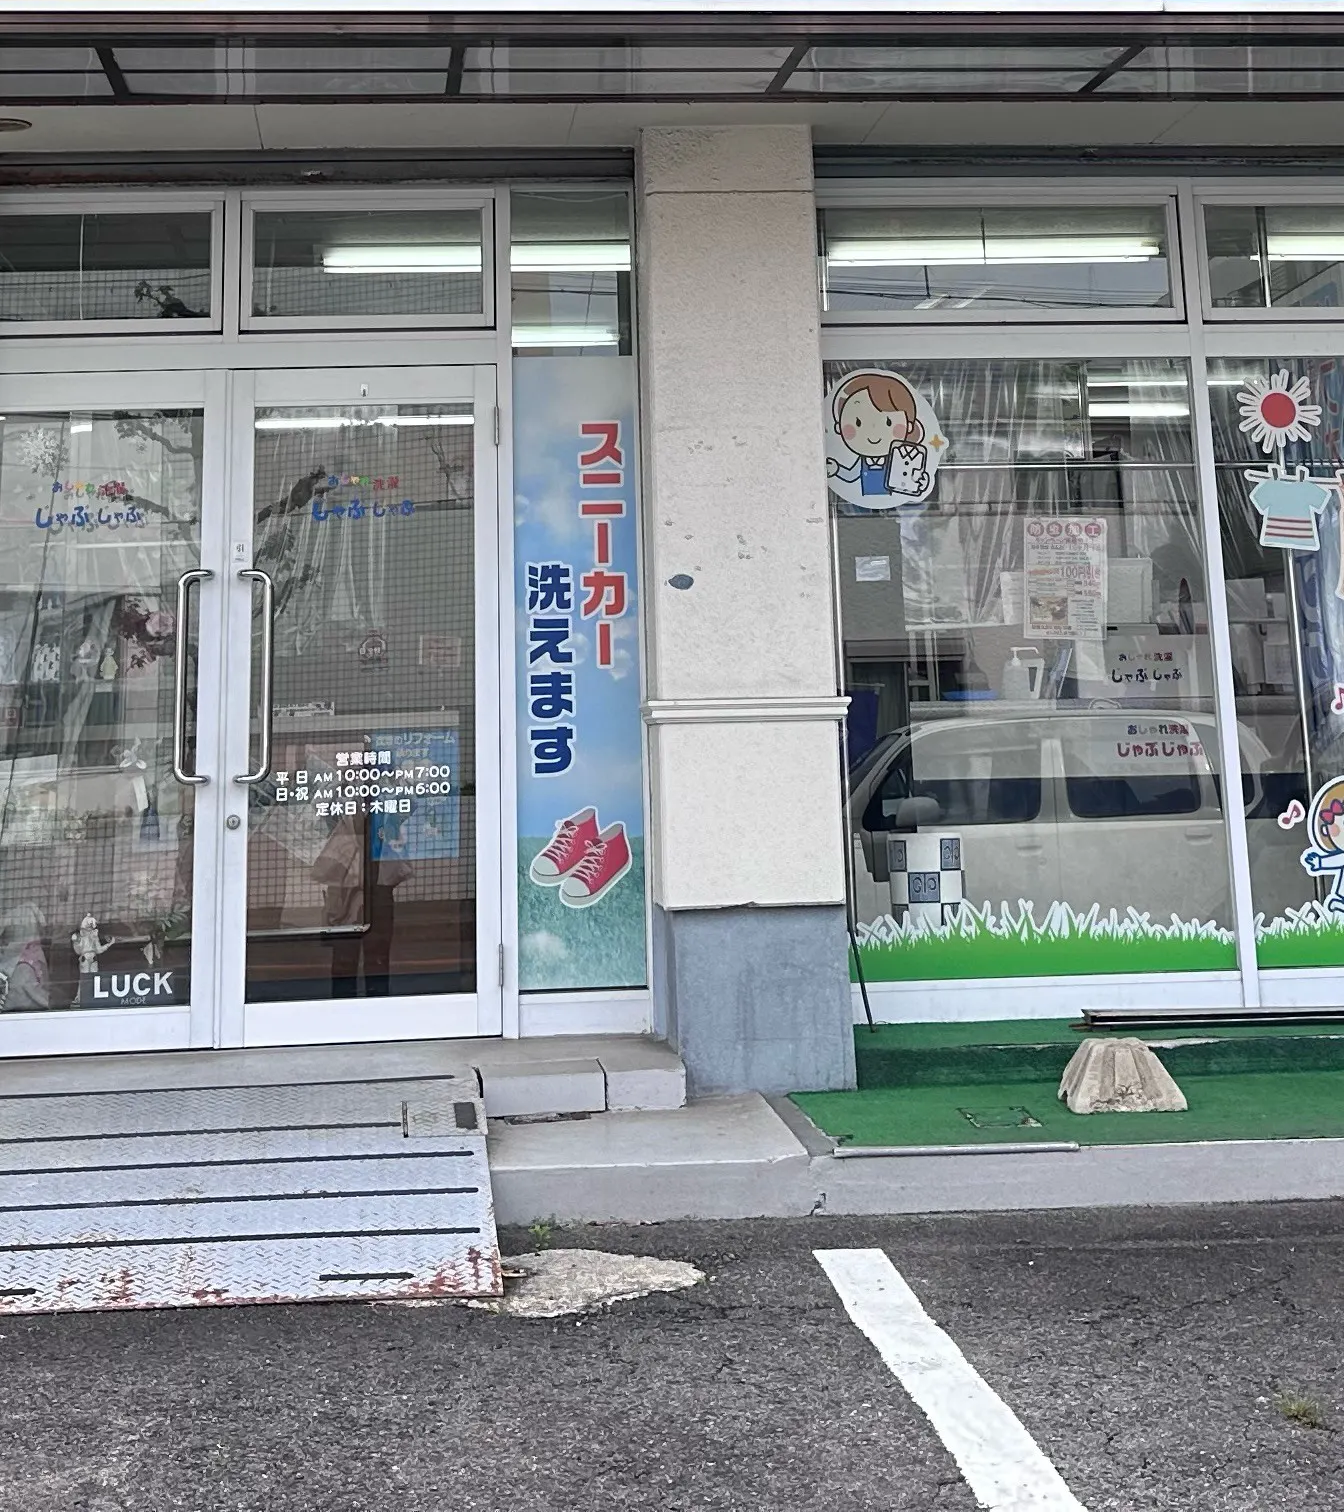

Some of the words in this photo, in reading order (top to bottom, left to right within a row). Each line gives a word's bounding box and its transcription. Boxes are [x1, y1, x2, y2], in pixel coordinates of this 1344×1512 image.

[579, 422, 628, 668] スニーカー
[528, 562, 575, 775] 洗えます
[336, 751, 391, 766] 営業時間
[93, 971, 173, 999] LUCK
